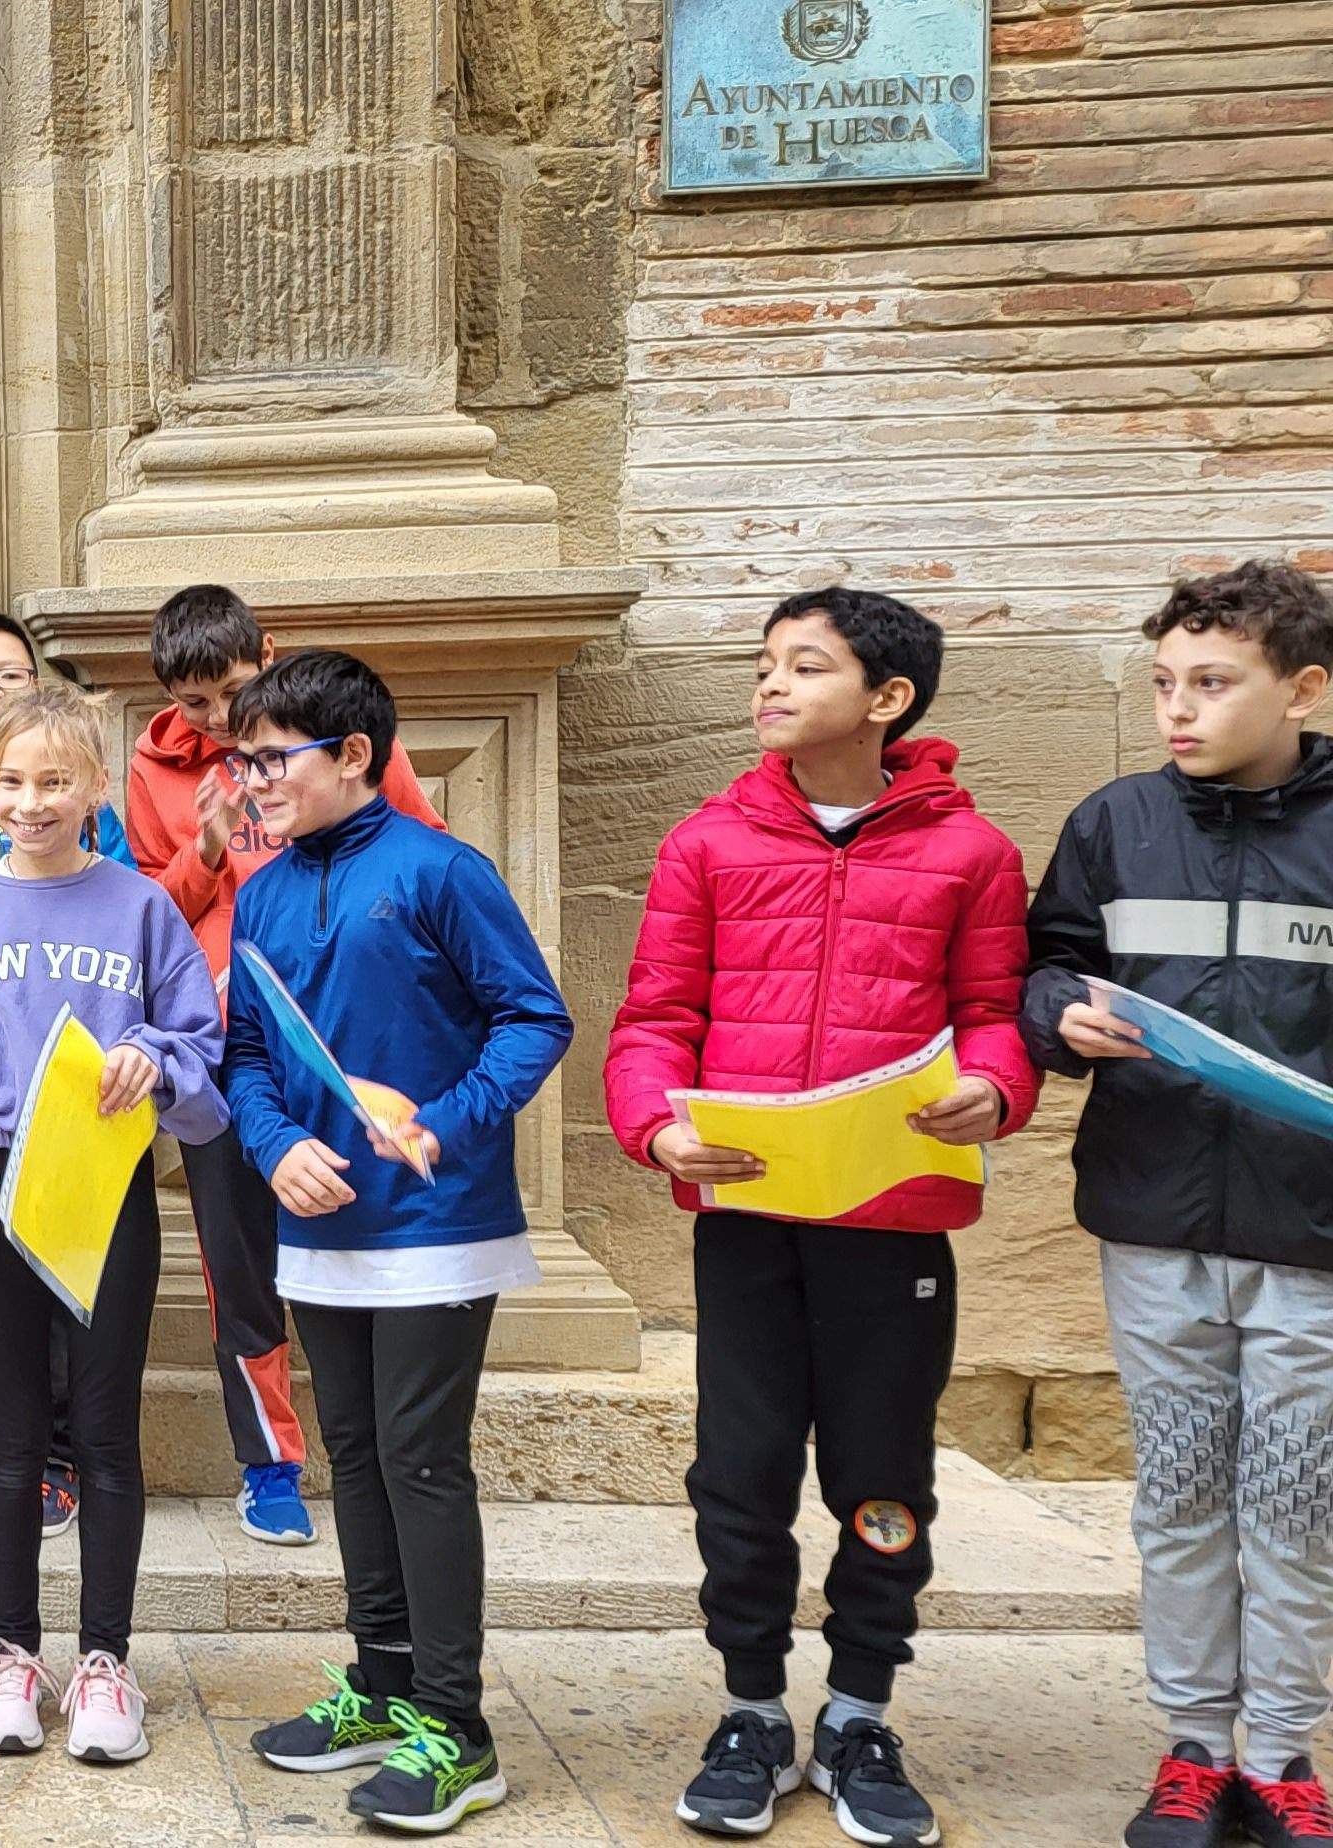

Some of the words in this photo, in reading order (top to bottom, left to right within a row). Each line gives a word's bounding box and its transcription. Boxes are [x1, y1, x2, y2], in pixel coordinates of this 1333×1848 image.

[682, 74, 975, 117] AYUNTAMIENTO
[720, 125, 758, 150] DE
[774, 114, 932, 166] HUESCA
